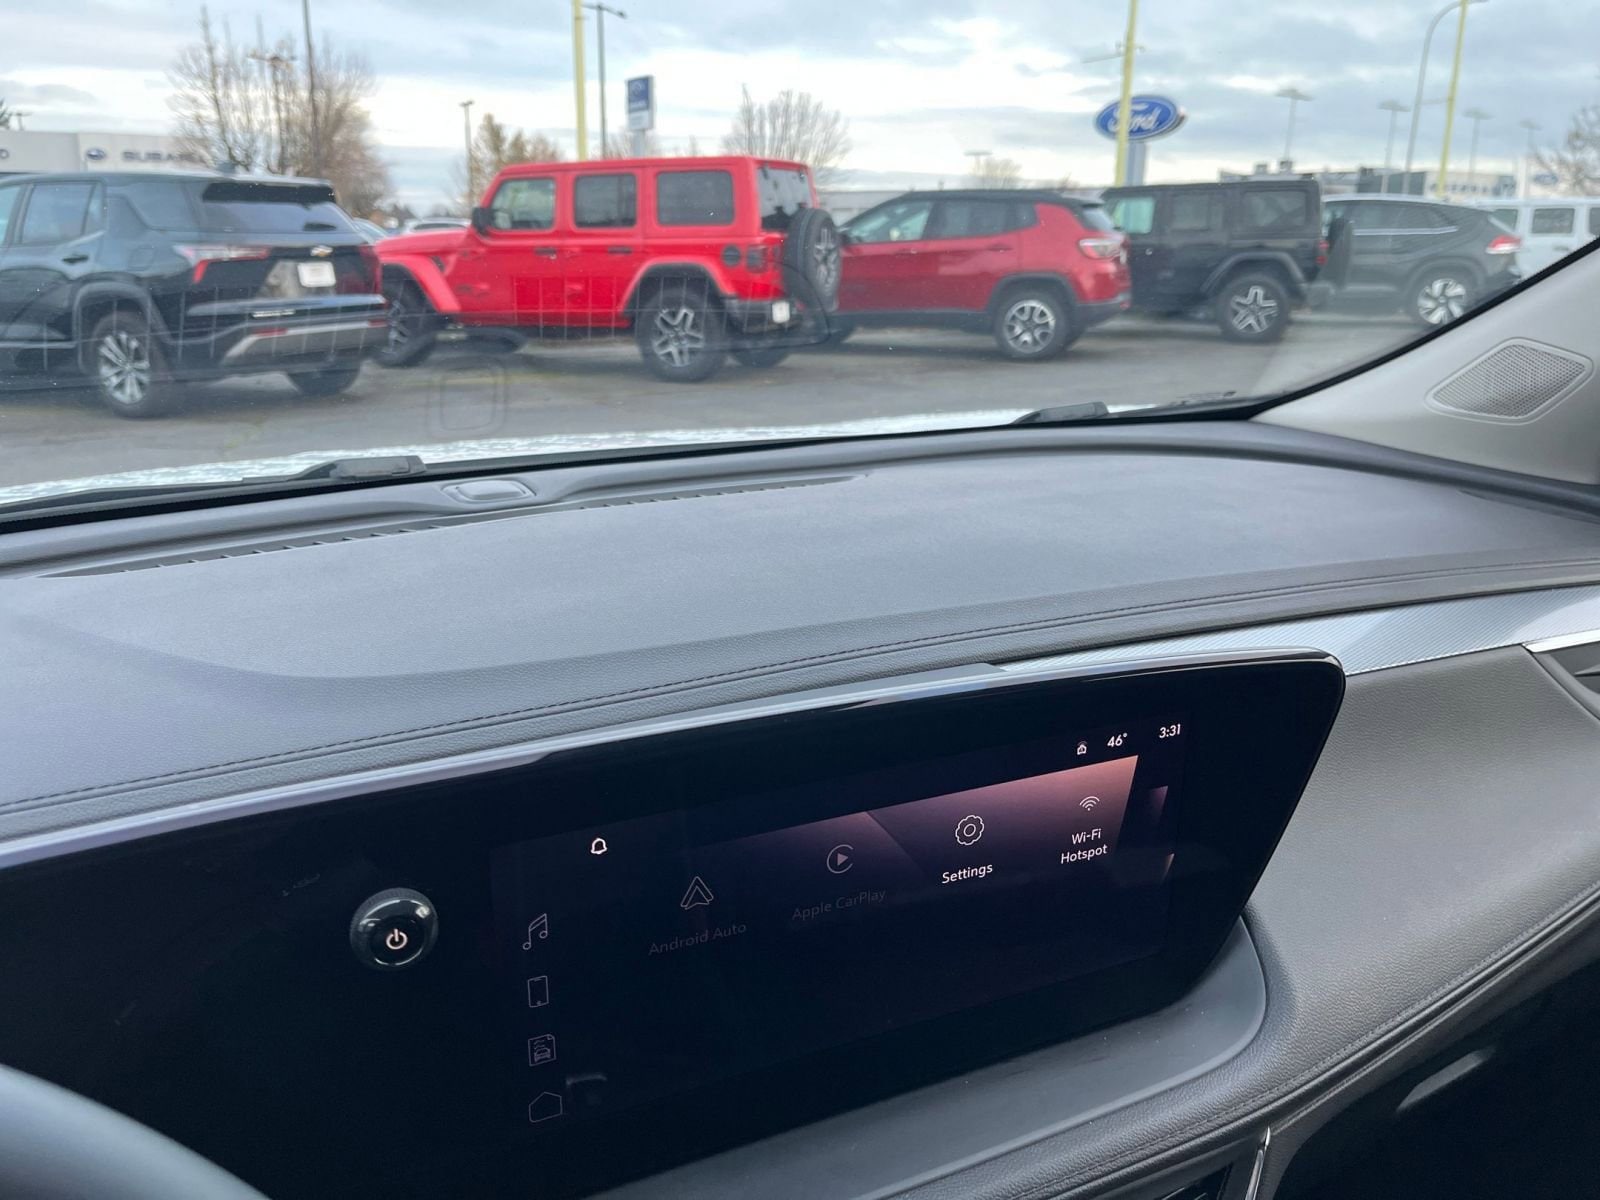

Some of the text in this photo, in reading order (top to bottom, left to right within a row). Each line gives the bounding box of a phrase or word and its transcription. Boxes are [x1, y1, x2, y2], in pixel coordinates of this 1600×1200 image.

[1106, 104, 1162, 133] Frd
[123, 151, 206, 163] SUBA
[1158, 723, 1182, 739] 3:31
[1071, 828, 1102, 845] Wi-Fi
[1060, 844, 1108, 865] Hotspot
[941, 863, 993, 884] Settings
[792, 889, 886, 921] Apple CarPlay
[648, 923, 748, 956] Android Auto
